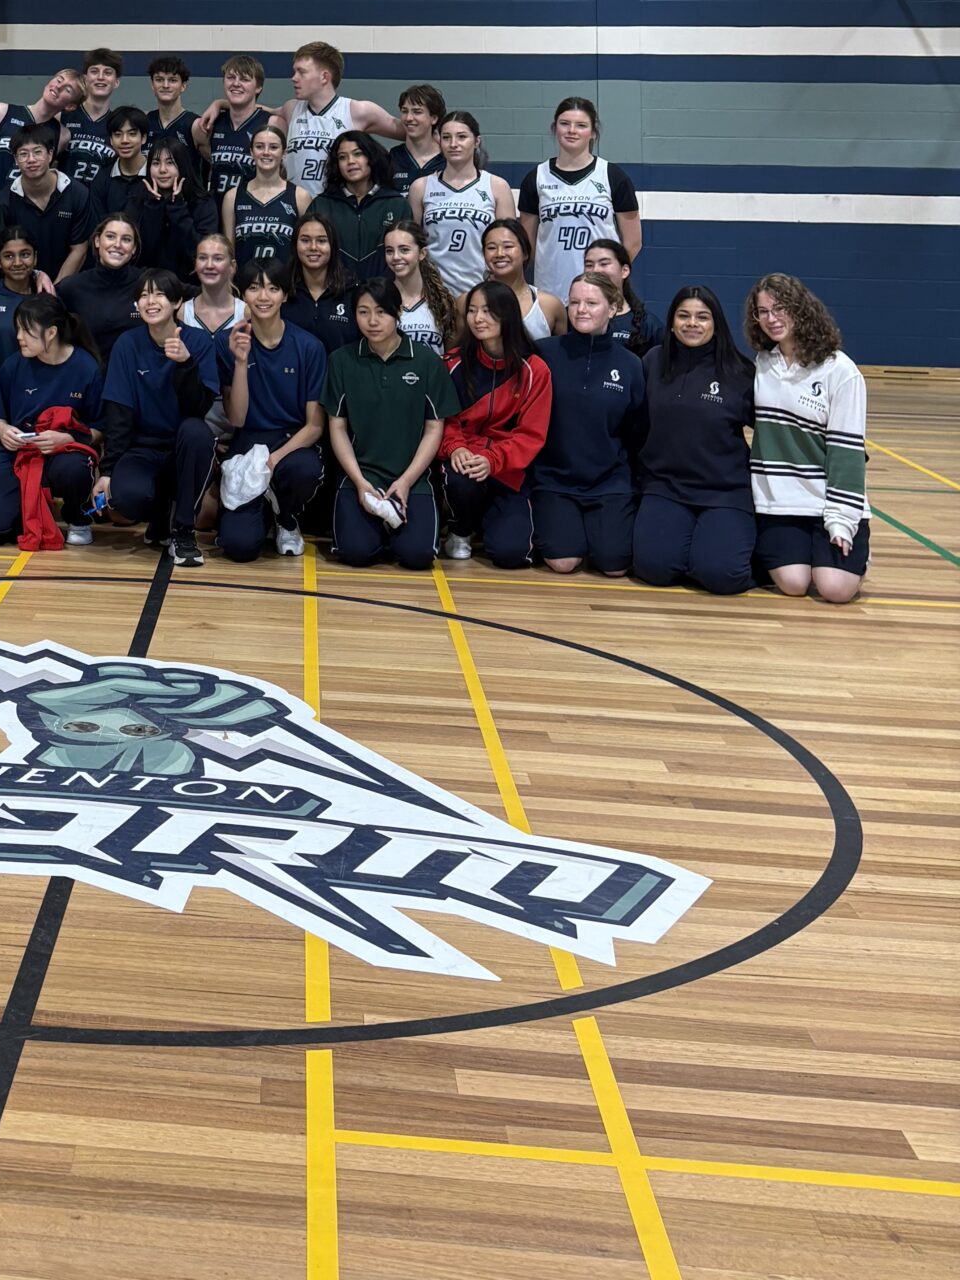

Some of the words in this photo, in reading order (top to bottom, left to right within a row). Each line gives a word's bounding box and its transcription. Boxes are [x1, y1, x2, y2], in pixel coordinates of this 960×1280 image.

[73, 133, 106, 143] SHENTON
[287, 136, 335, 154] STOR
[68, 140, 117, 160] TORM
[73, 161, 100, 181] 23
[301, 158, 327, 181] 21
[217, 174, 242, 192] 34
[551, 194, 591, 202] SHENTON
[425, 207, 492, 231] STORM
[540, 202, 609, 226] STORM
[235, 222, 294, 242] STORM
[448, 229, 467, 252] 9
[558, 226, 591, 251] 40
